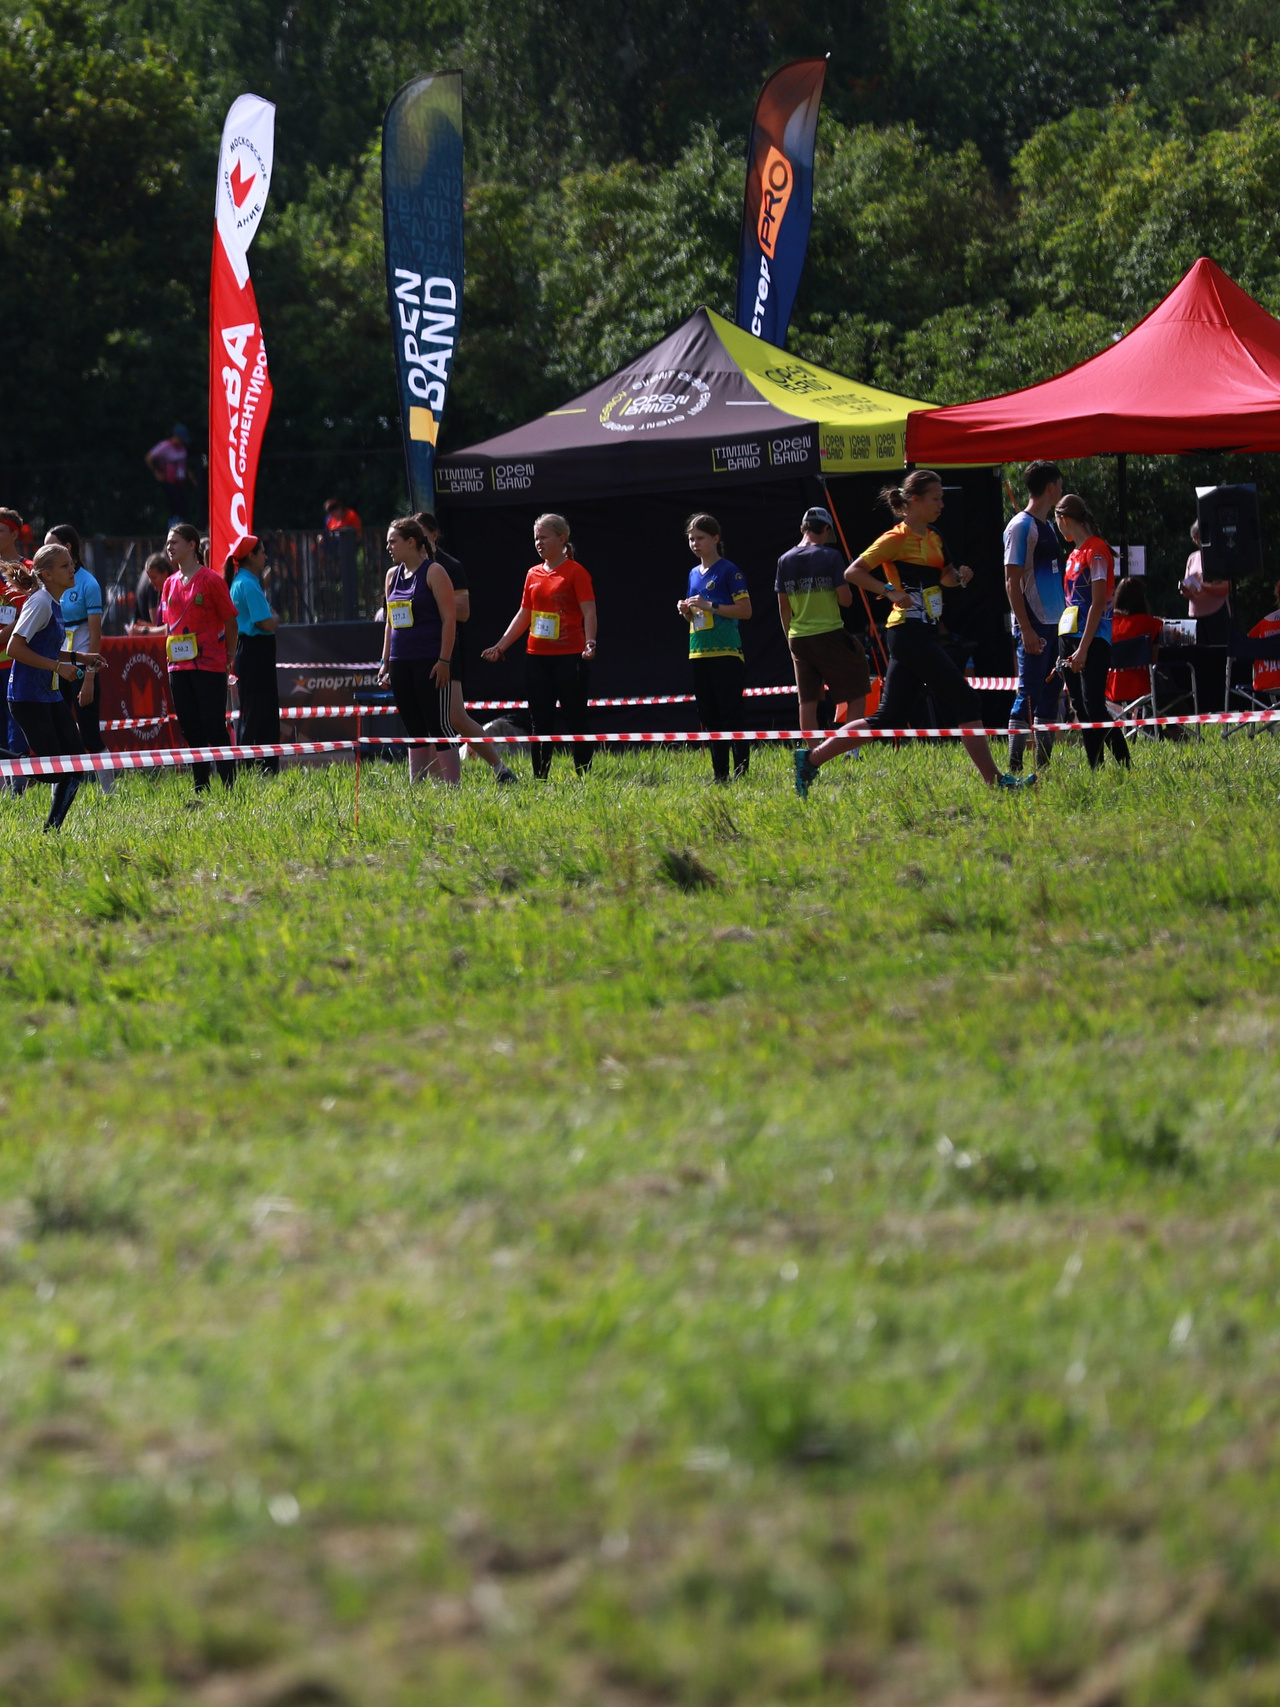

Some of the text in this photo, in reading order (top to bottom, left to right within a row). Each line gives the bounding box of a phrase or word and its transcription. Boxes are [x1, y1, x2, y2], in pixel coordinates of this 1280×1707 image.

[761, 159, 788, 248] PRO
[394, 268, 429, 400] OPEN
[420, 276, 457, 412] BAND
[624, 403, 677, 416] BAND
[221, 323, 256, 550] ОСКВА
[714, 443, 761, 459] TIMING
[773, 449, 809, 465] BAND
[727, 456, 761, 471] BAND
[437, 467, 484, 480] TIMING
[450, 480, 484, 493] BAND
[496, 476, 532, 490] BAND
